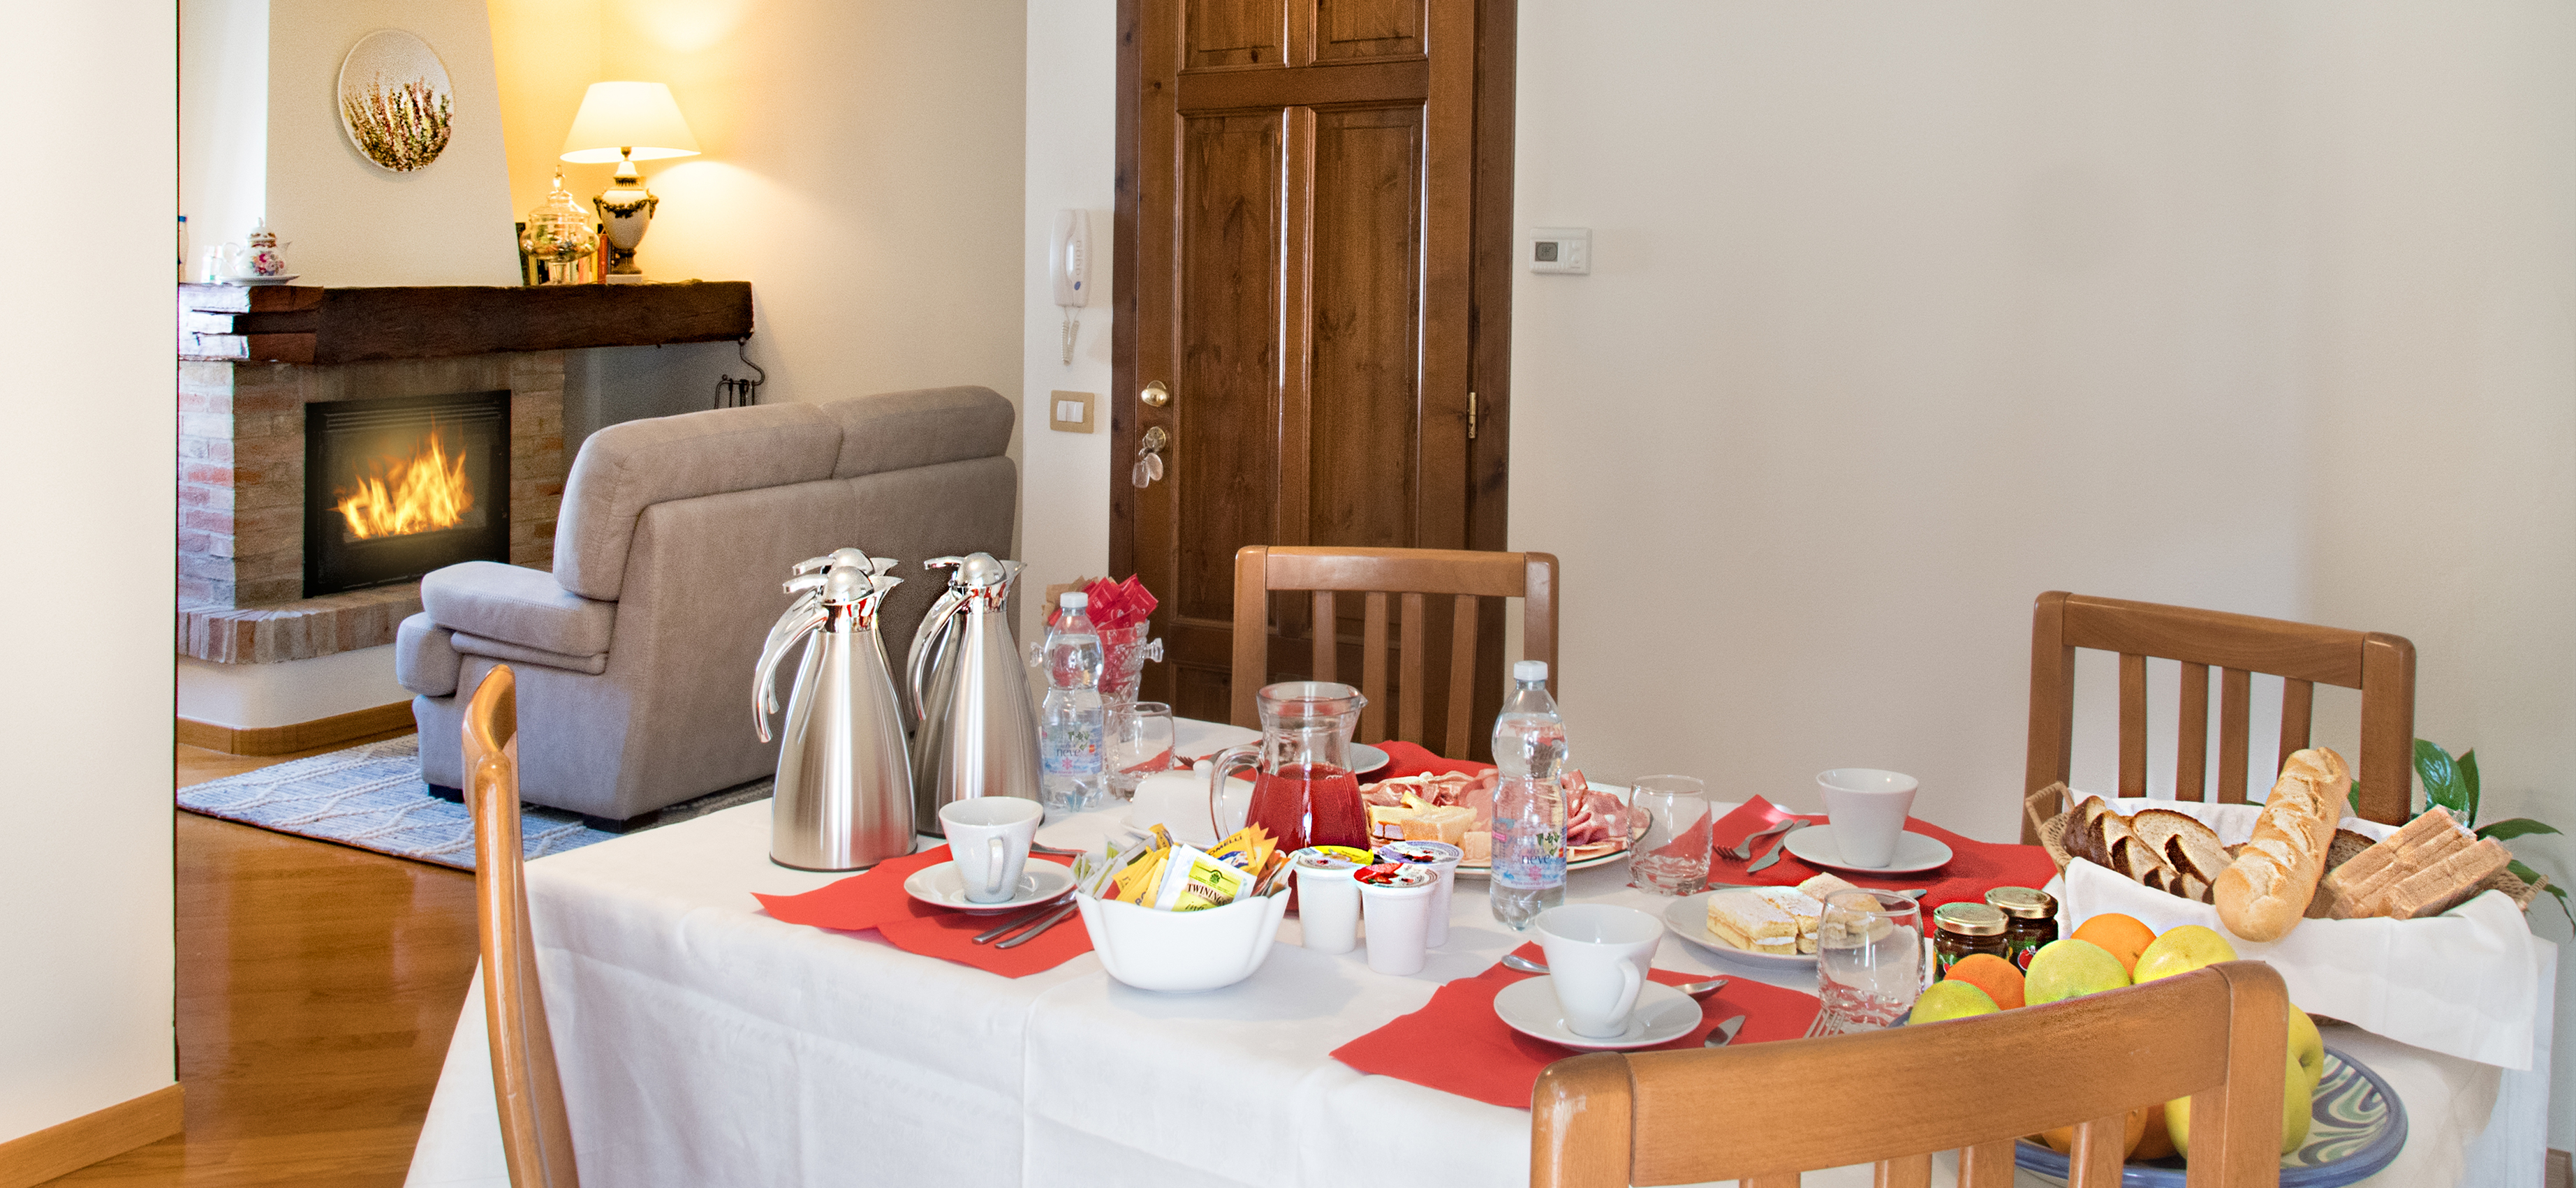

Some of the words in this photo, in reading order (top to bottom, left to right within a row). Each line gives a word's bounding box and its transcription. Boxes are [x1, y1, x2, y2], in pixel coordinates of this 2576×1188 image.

[1057, 748, 1080, 757] neve
[1522, 854, 1550, 865] neve
[1188, 884, 1228, 906] TWININGS
